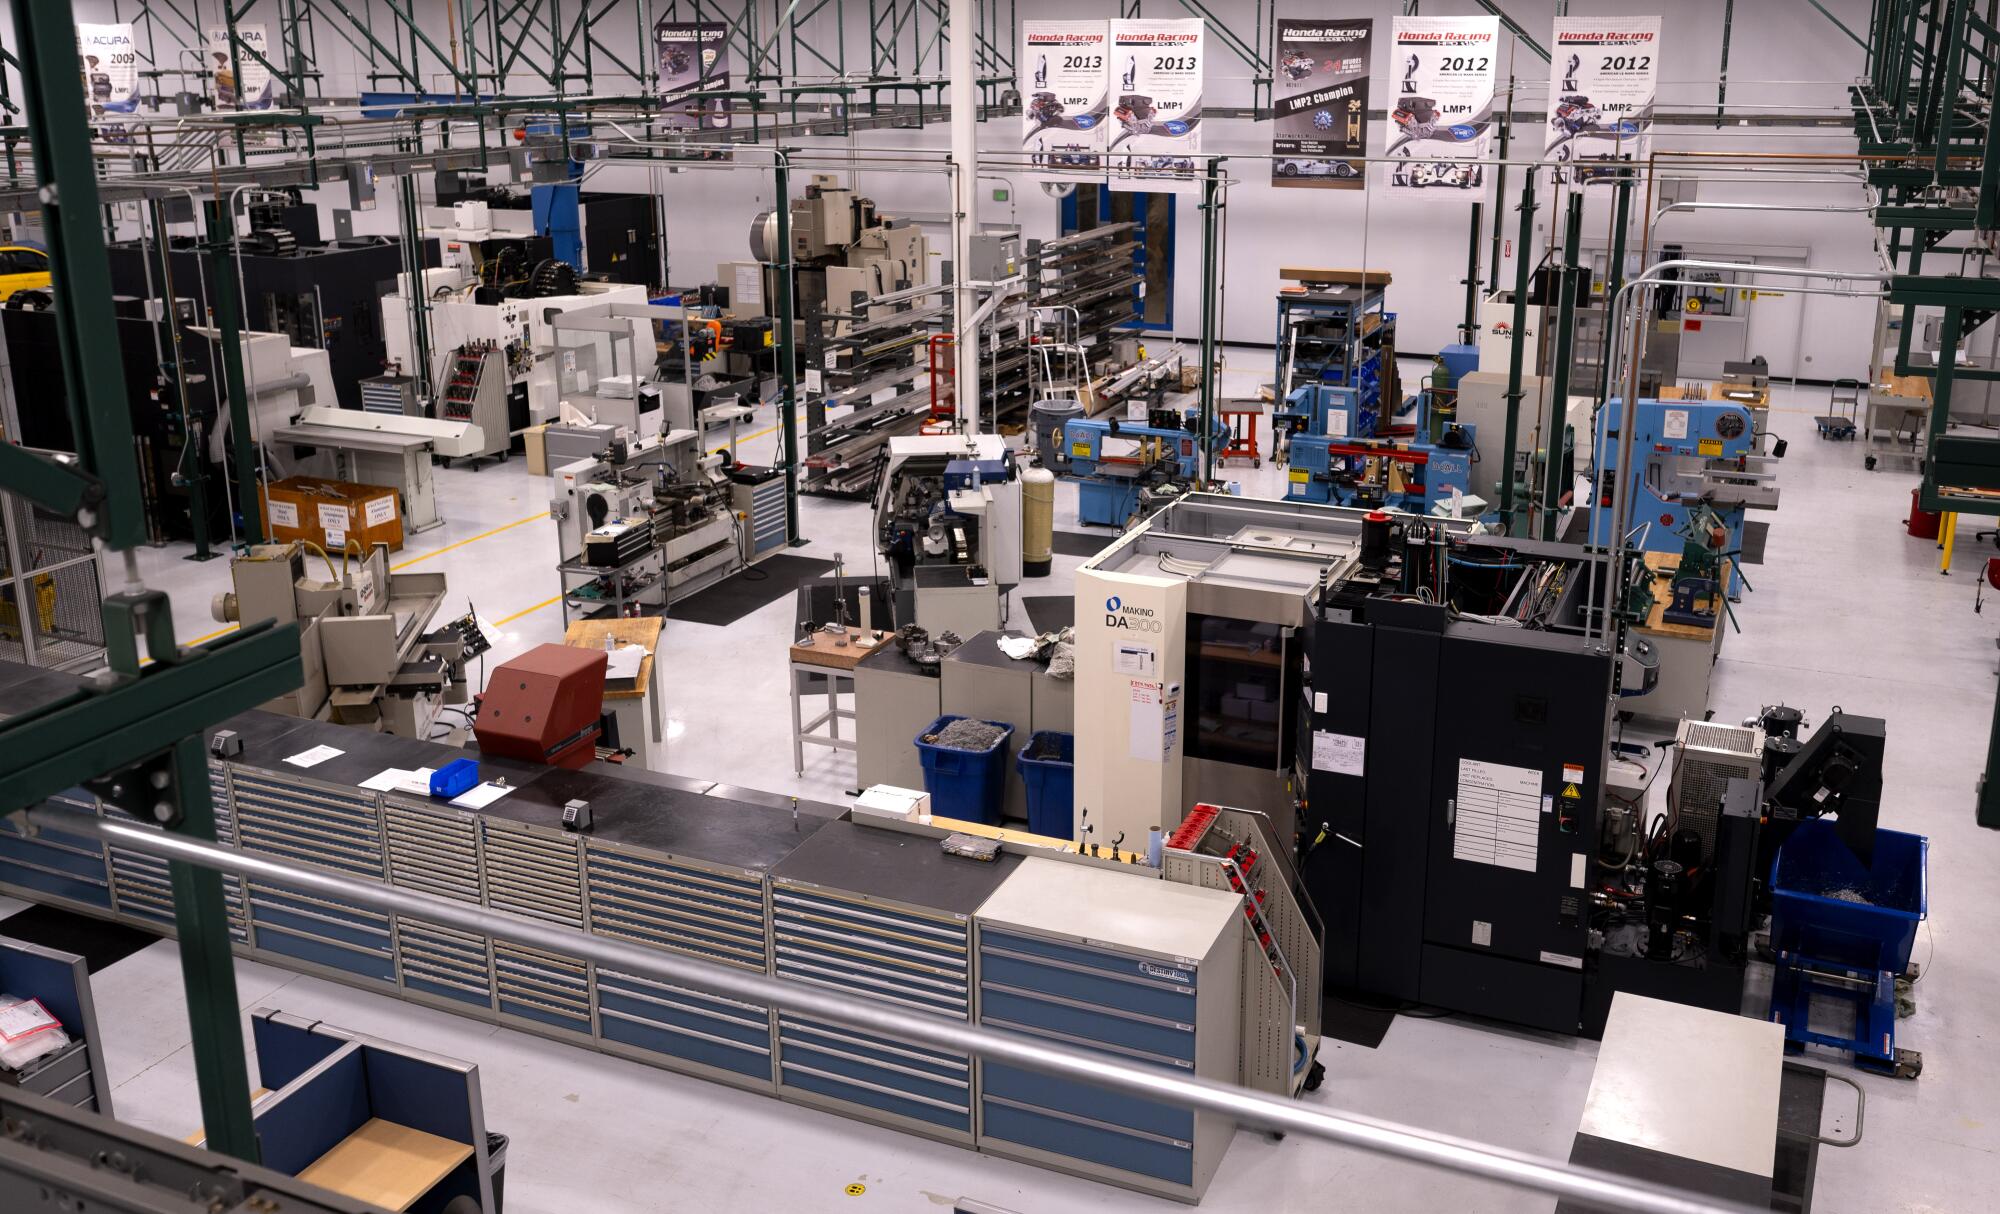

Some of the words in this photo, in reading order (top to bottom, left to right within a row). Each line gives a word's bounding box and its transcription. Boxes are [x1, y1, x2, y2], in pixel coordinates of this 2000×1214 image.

[221, 32, 263, 41] AURA
[1115, 33, 1155, 41] Honda
[1156, 33, 1198, 43] Racing
[1283, 28, 1323, 37] Honda
[1324, 28, 1368, 38] Racing
[1398, 32, 1442, 40] Honda
[1444, 32, 1492, 42] Racing
[1559, 32, 1603, 40] Honda
[1605, 32, 1654, 42] Racing
[93, 36, 130, 45] ACURA
[1065, 34, 1104, 43] Racing
[110, 53, 135, 64] 2009
[241, 50, 267, 62] 209
[1063, 55, 1103, 68] 2013
[1153, 57, 1197, 70] 2013
[1440, 57, 1489, 71] 2012
[1601, 56, 1651, 70] 2012
[1063, 97, 1088, 105] LMP2
[1290, 97, 1312, 110] LMP2
[1313, 86, 1354, 103] Champion
[1157, 102, 1183, 110] LMP1
[1442, 104, 1472, 113] LMP1
[1602, 103, 1632, 112] LMP2
[1492, 329, 1532, 337] SUNN
[1122, 606, 1154, 618] MAKINO
[1105, 614, 1163, 634] DA300
[1149, 965, 1173, 975] DESTINY
